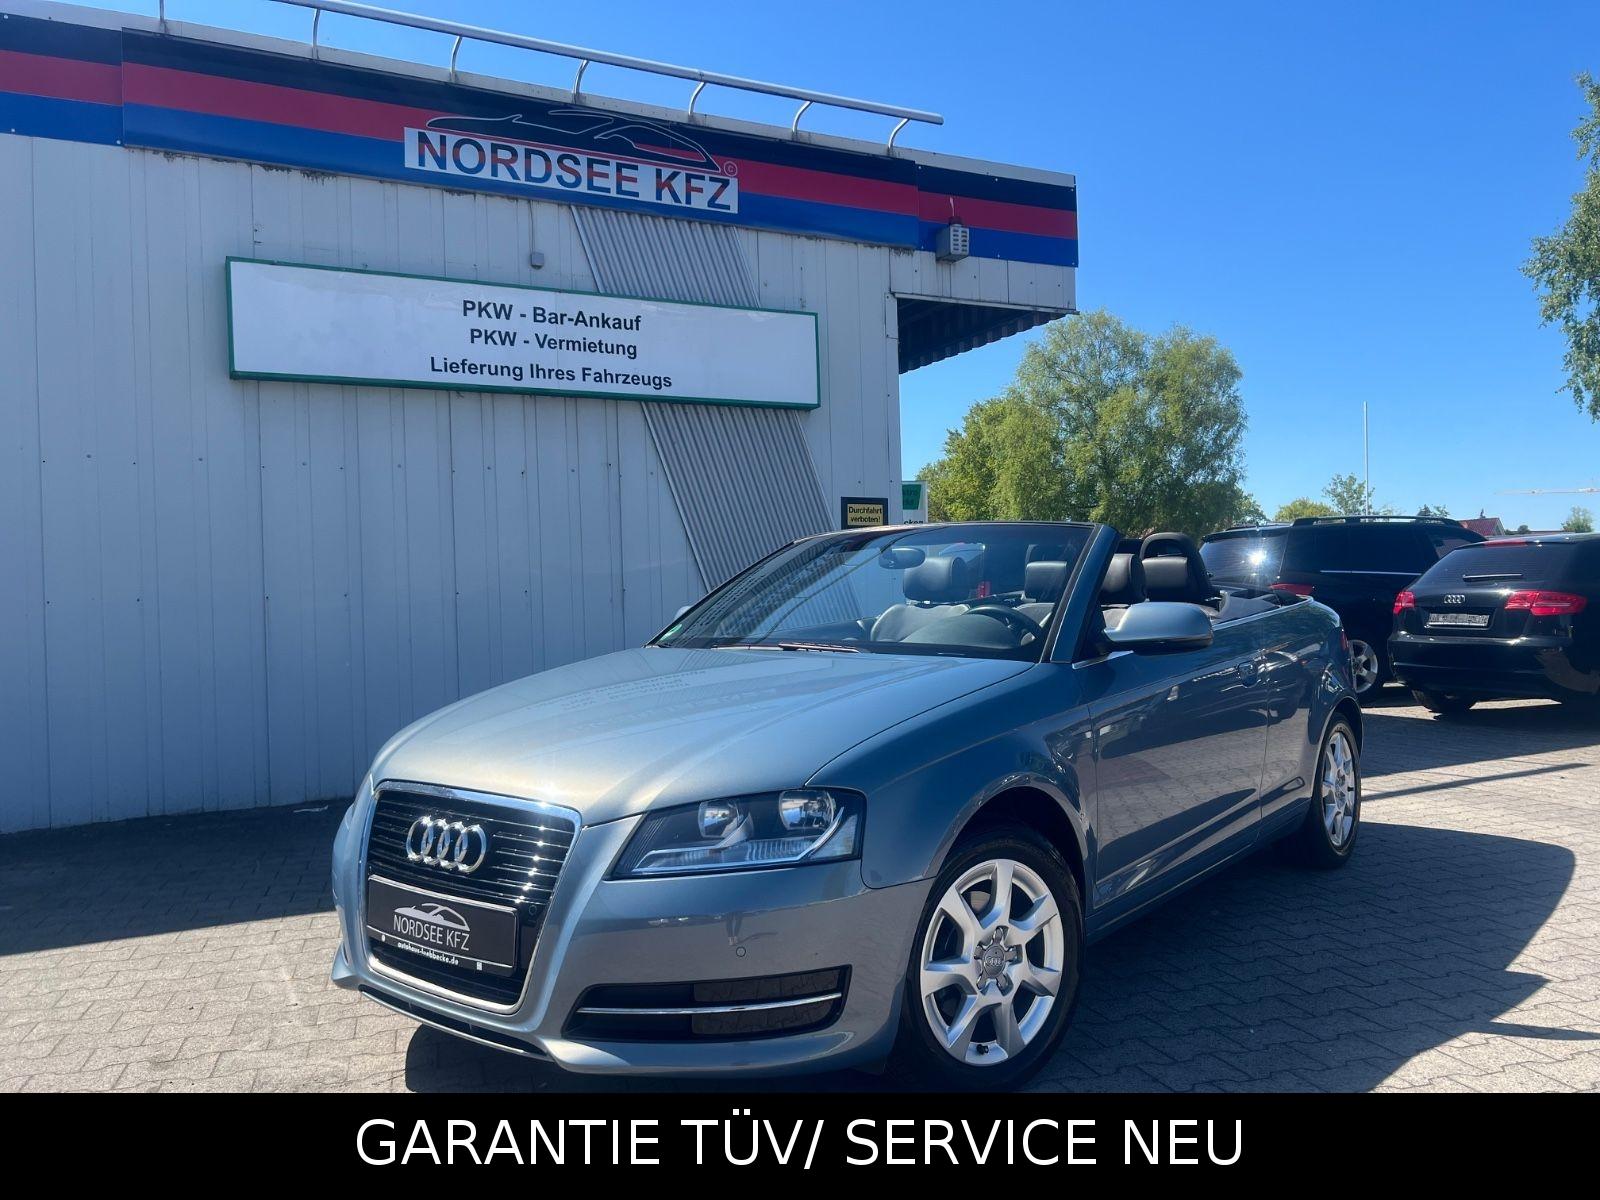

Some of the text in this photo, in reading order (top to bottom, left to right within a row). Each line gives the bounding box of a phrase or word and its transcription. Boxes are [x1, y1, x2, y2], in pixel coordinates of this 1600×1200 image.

[417, 130, 731, 211] NORDSEE KFZ
[462, 299, 514, 321] PKW
[532, 306, 641, 331] Bar-Ankauf
[470, 328, 517, 347] PKW
[534, 333, 637, 359] Vermietung
[430, 356, 672, 390] Lieferung Ihres Fahrzeugs
[848, 506, 882, 514] Durchfahrt
[393, 914, 471, 951] NORDSEE KFZ
